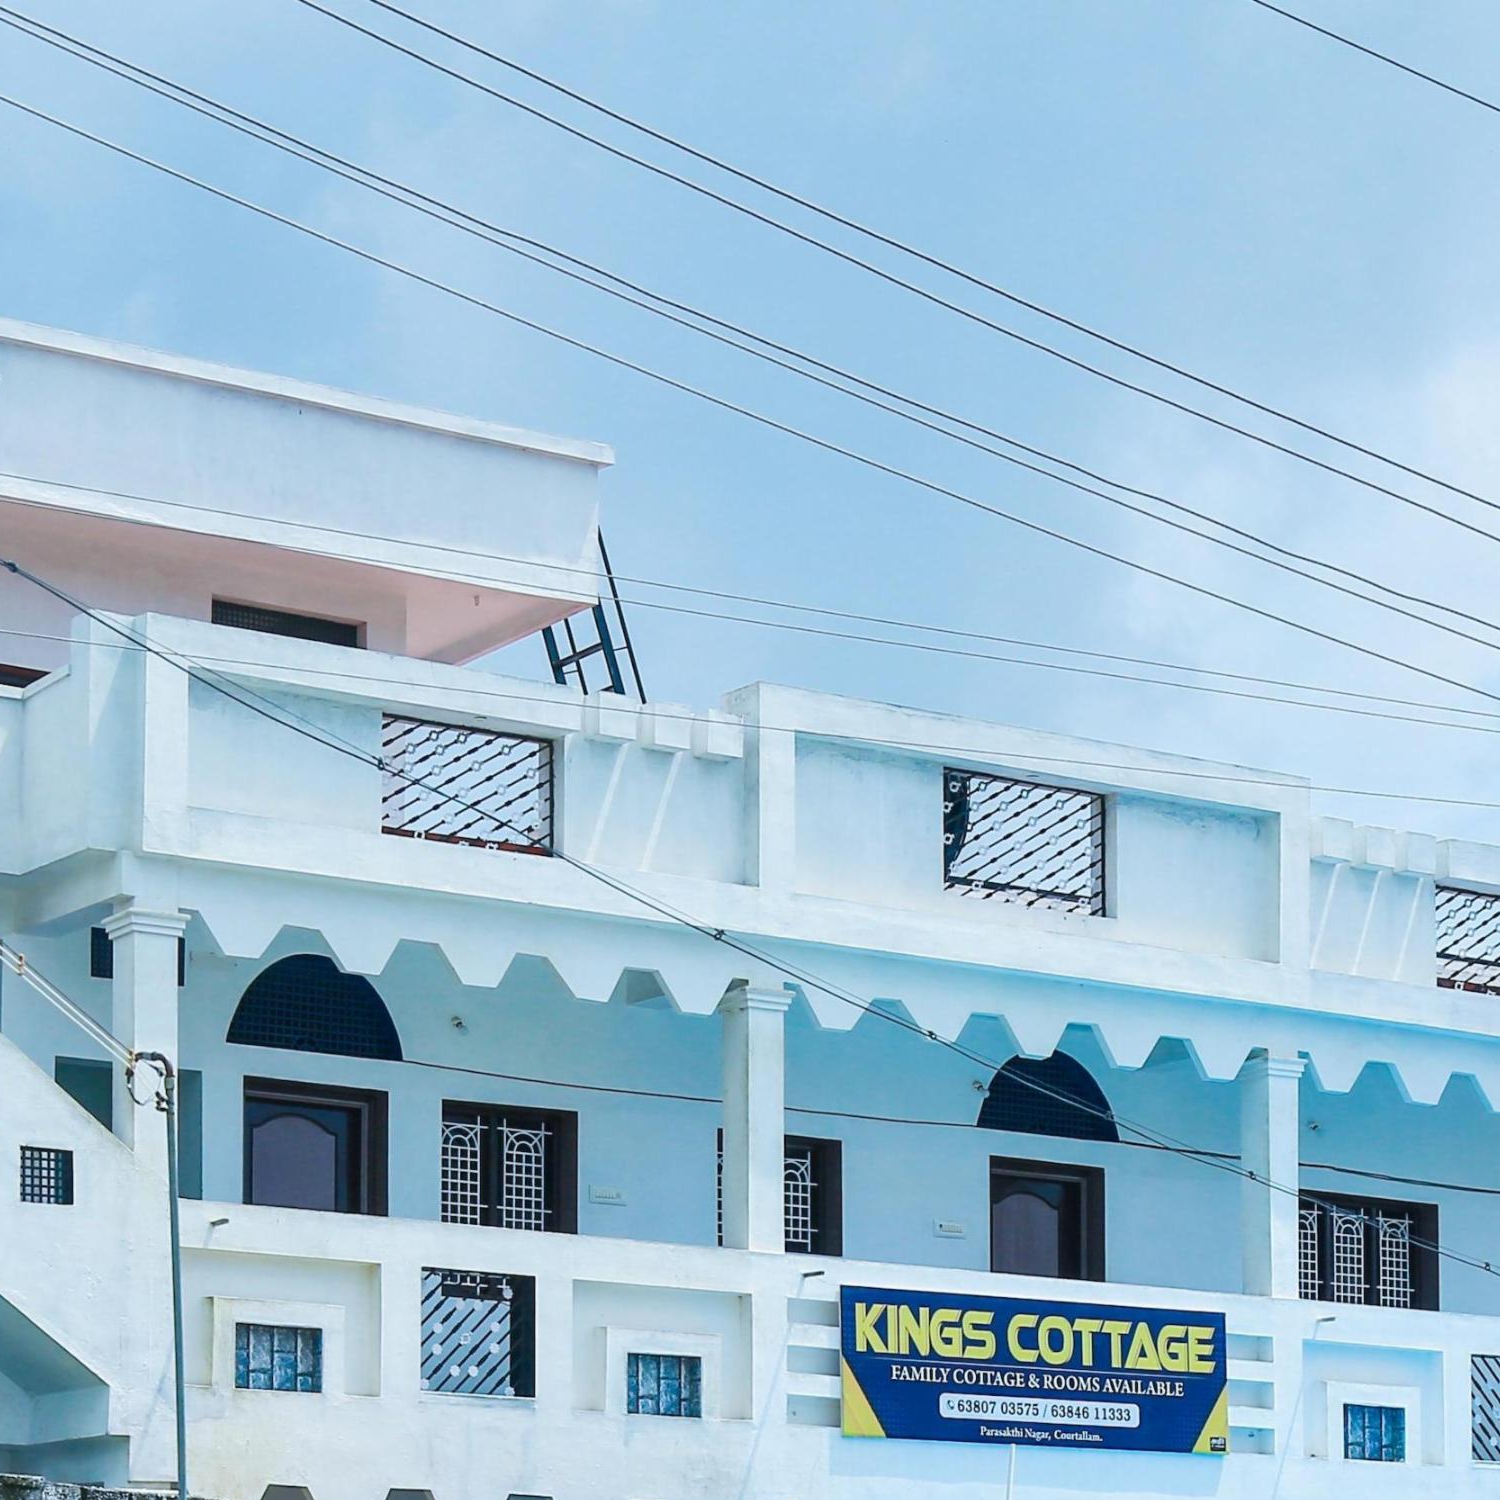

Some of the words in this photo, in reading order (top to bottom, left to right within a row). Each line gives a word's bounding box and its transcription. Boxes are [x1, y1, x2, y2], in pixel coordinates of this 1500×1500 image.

[854, 1302, 996, 1361] KINGS
[1007, 1314, 1216, 1373] COTTAGE
[891, 1364, 949, 1384] FAMILY
[953, 1369, 1025, 1388] COTTAGE
[1028, 1374, 1040, 1388] &
[1042, 1374, 1100, 1393] ROOMS
[1102, 1378, 1184, 1397] AVAILABLE
[957, 1399, 996, 1415] 63807
[1000, 1401, 1040, 1418] 03575
[1050, 1404, 1090, 1420] 63846
[1093, 1407, 1131, 1422] 11333
[979, 1425, 1023, 1439] Parasakthi
[1024, 1428, 1052, 1442] Nagar,
